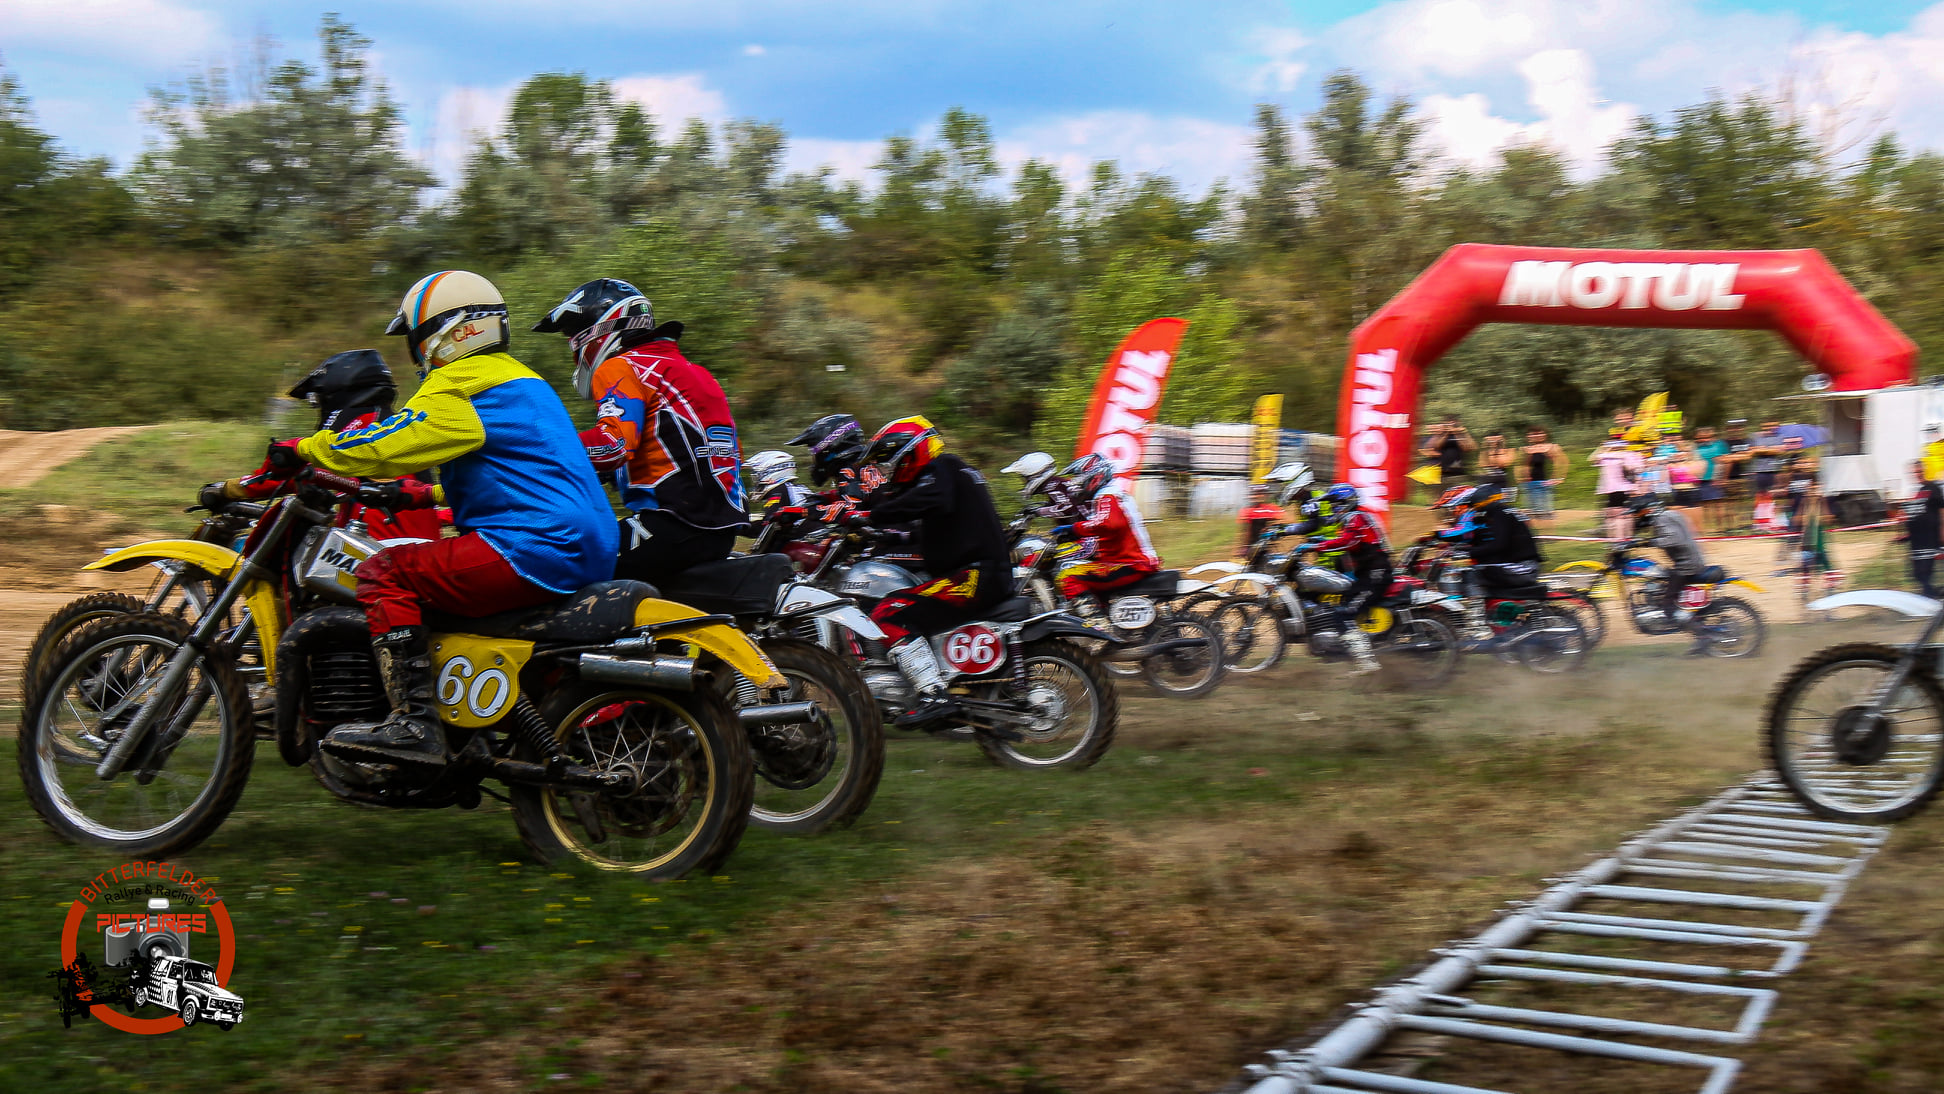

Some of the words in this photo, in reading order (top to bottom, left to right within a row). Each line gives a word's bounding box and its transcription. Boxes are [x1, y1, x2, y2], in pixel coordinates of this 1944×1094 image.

[1496, 260, 1747, 311] MOTUL
[451, 323, 485, 343] CAL
[1091, 350, 1171, 495] OTUL
[1347, 348, 1399, 512] MOTUL
[949, 632, 995, 664] 66
[436, 655, 510, 718] 60
